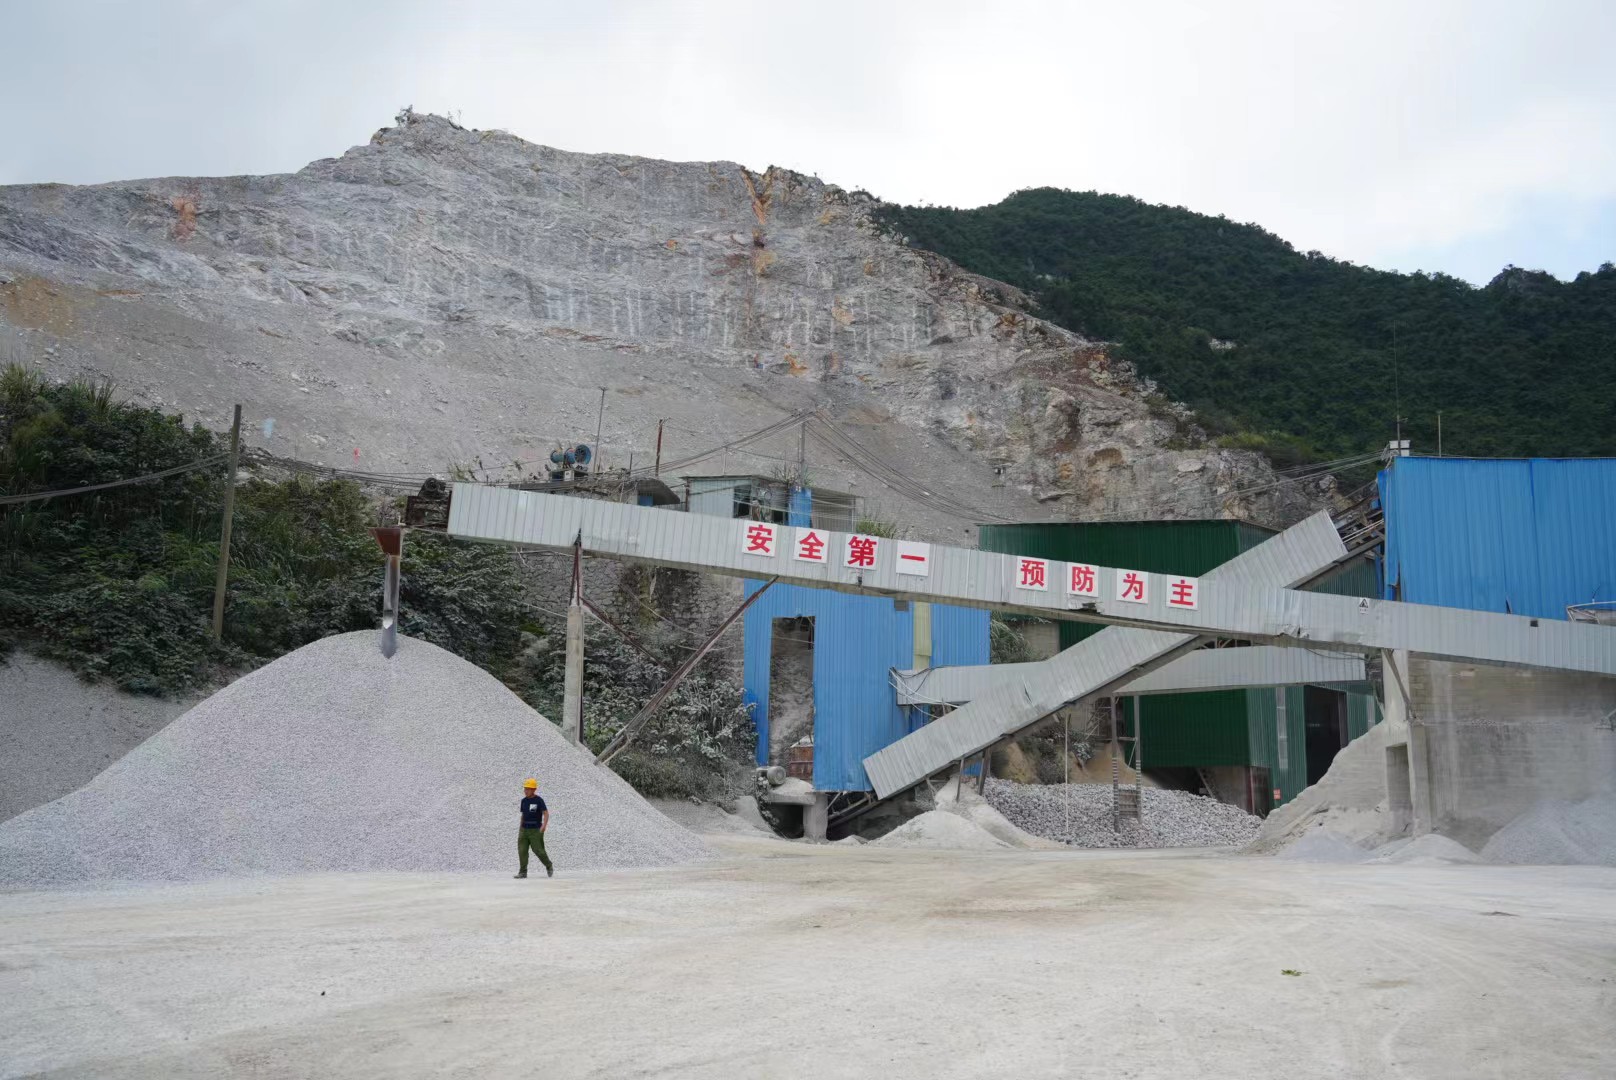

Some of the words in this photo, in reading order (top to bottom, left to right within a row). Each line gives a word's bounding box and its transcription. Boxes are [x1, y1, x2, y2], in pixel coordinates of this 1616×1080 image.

[747, 524, 927, 567] 安全第一
[1021, 559, 1195, 607] 预防为主
